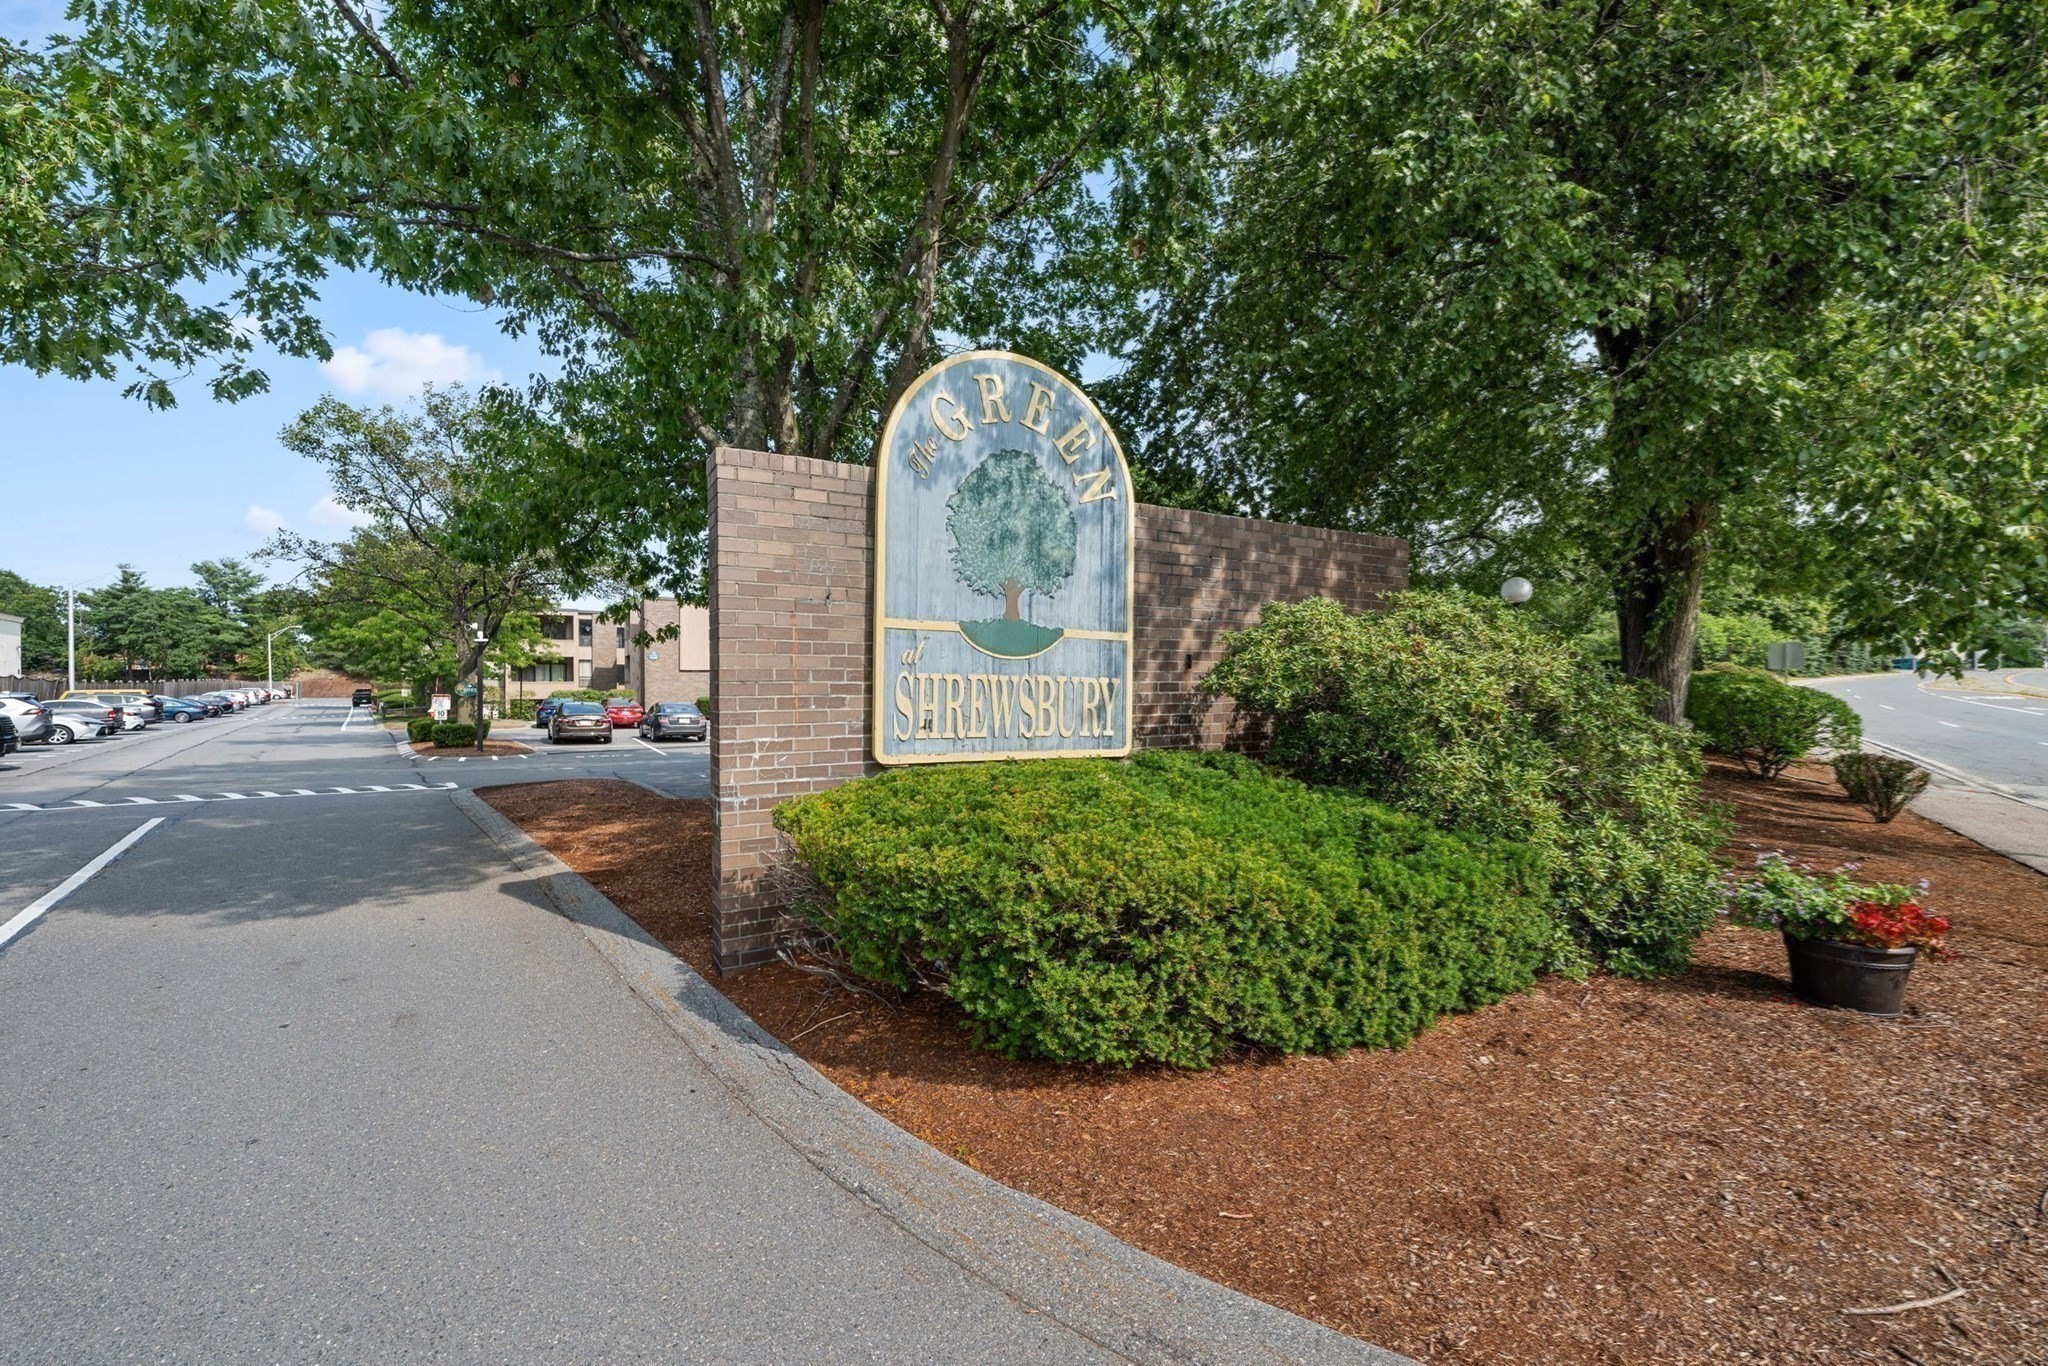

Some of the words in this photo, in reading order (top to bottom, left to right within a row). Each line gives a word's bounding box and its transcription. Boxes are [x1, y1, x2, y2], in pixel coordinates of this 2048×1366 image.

[908, 436, 937, 479] The
[930, 374, 1117, 504] GREEN
[901, 636, 927, 665] at
[893, 671, 1120, 742] SHREWSBURY
